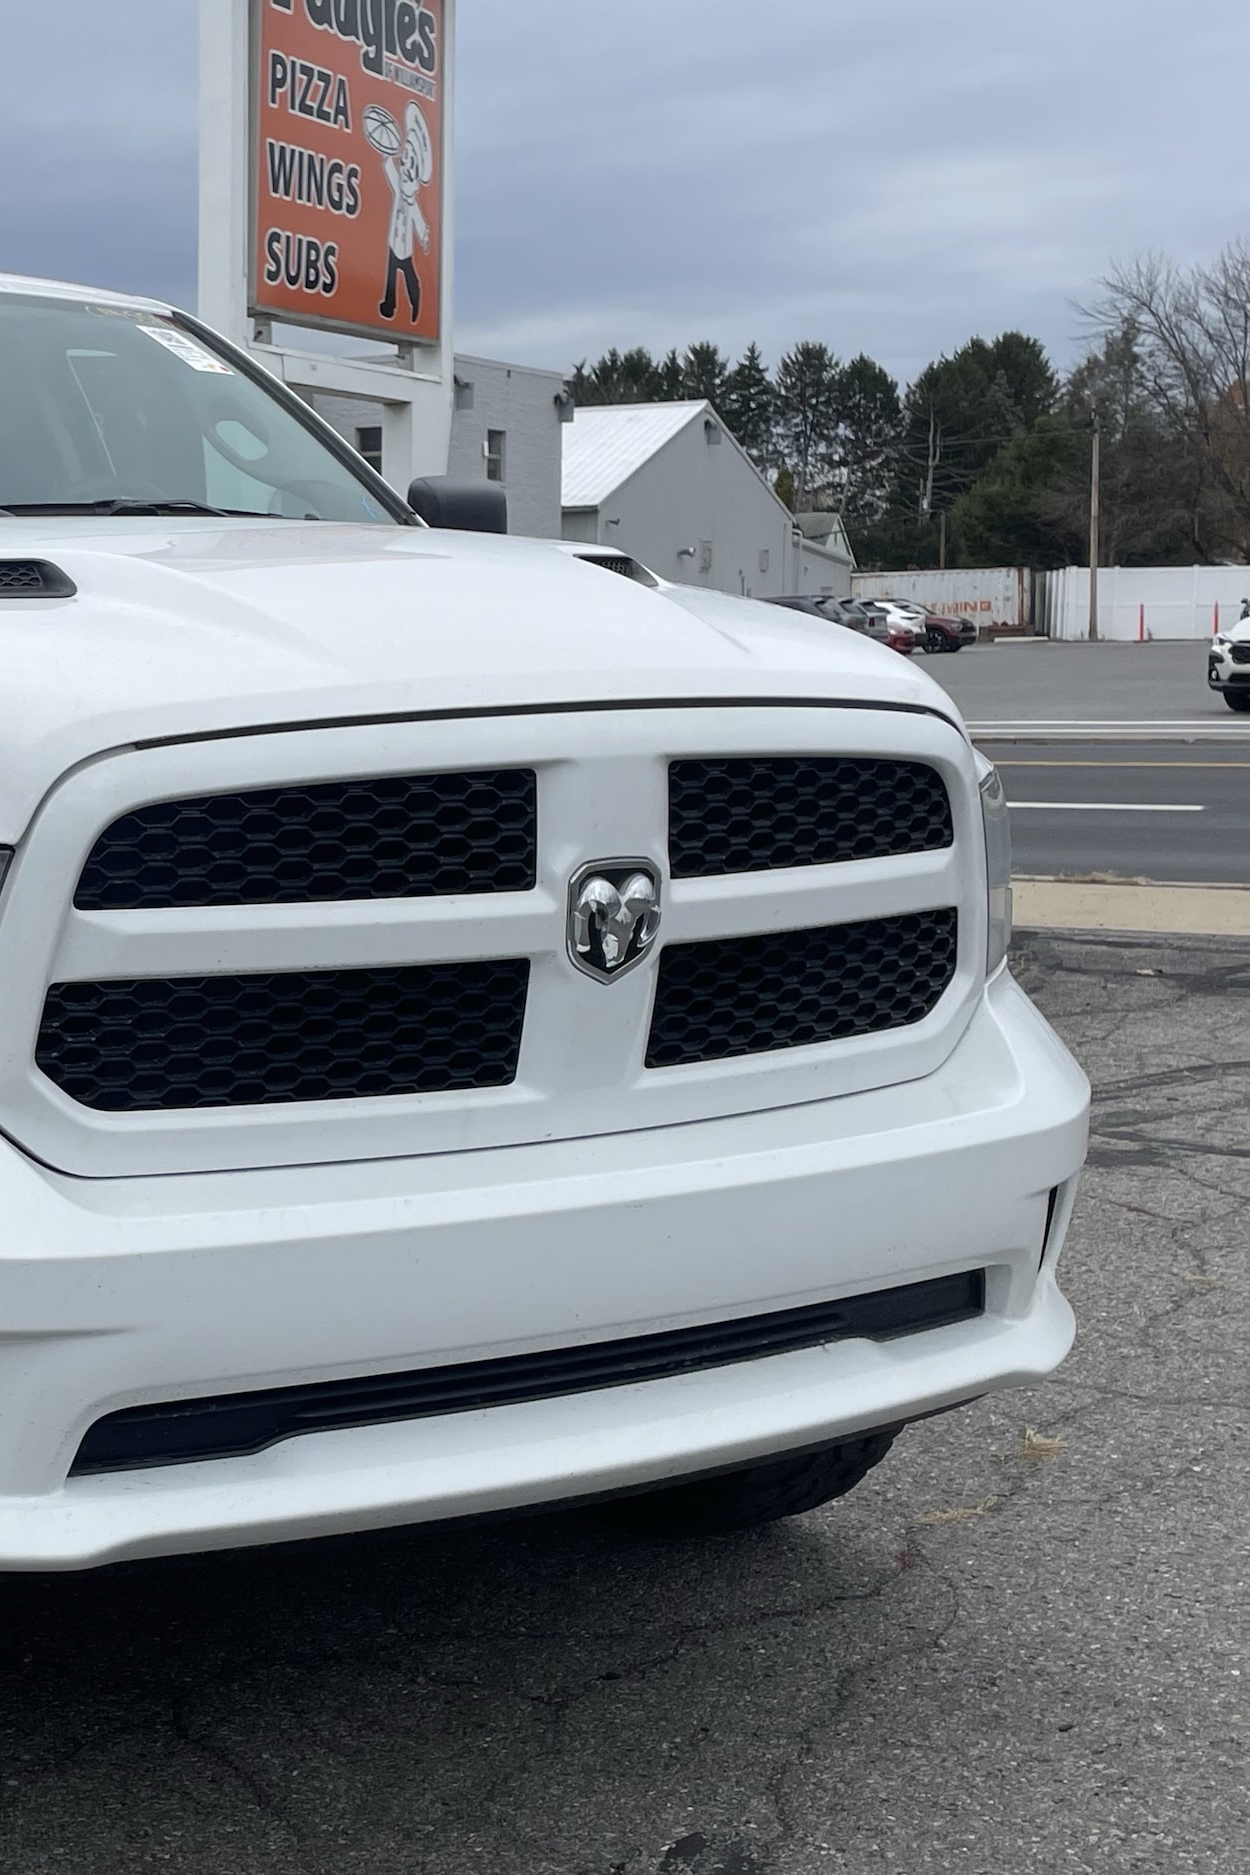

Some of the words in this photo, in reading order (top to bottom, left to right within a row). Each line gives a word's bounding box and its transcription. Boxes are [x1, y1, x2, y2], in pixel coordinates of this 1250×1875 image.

[269, 50, 352, 132] PIZZA
[266, 139, 360, 217] WINGS
[264, 228, 338, 296] SUBS
